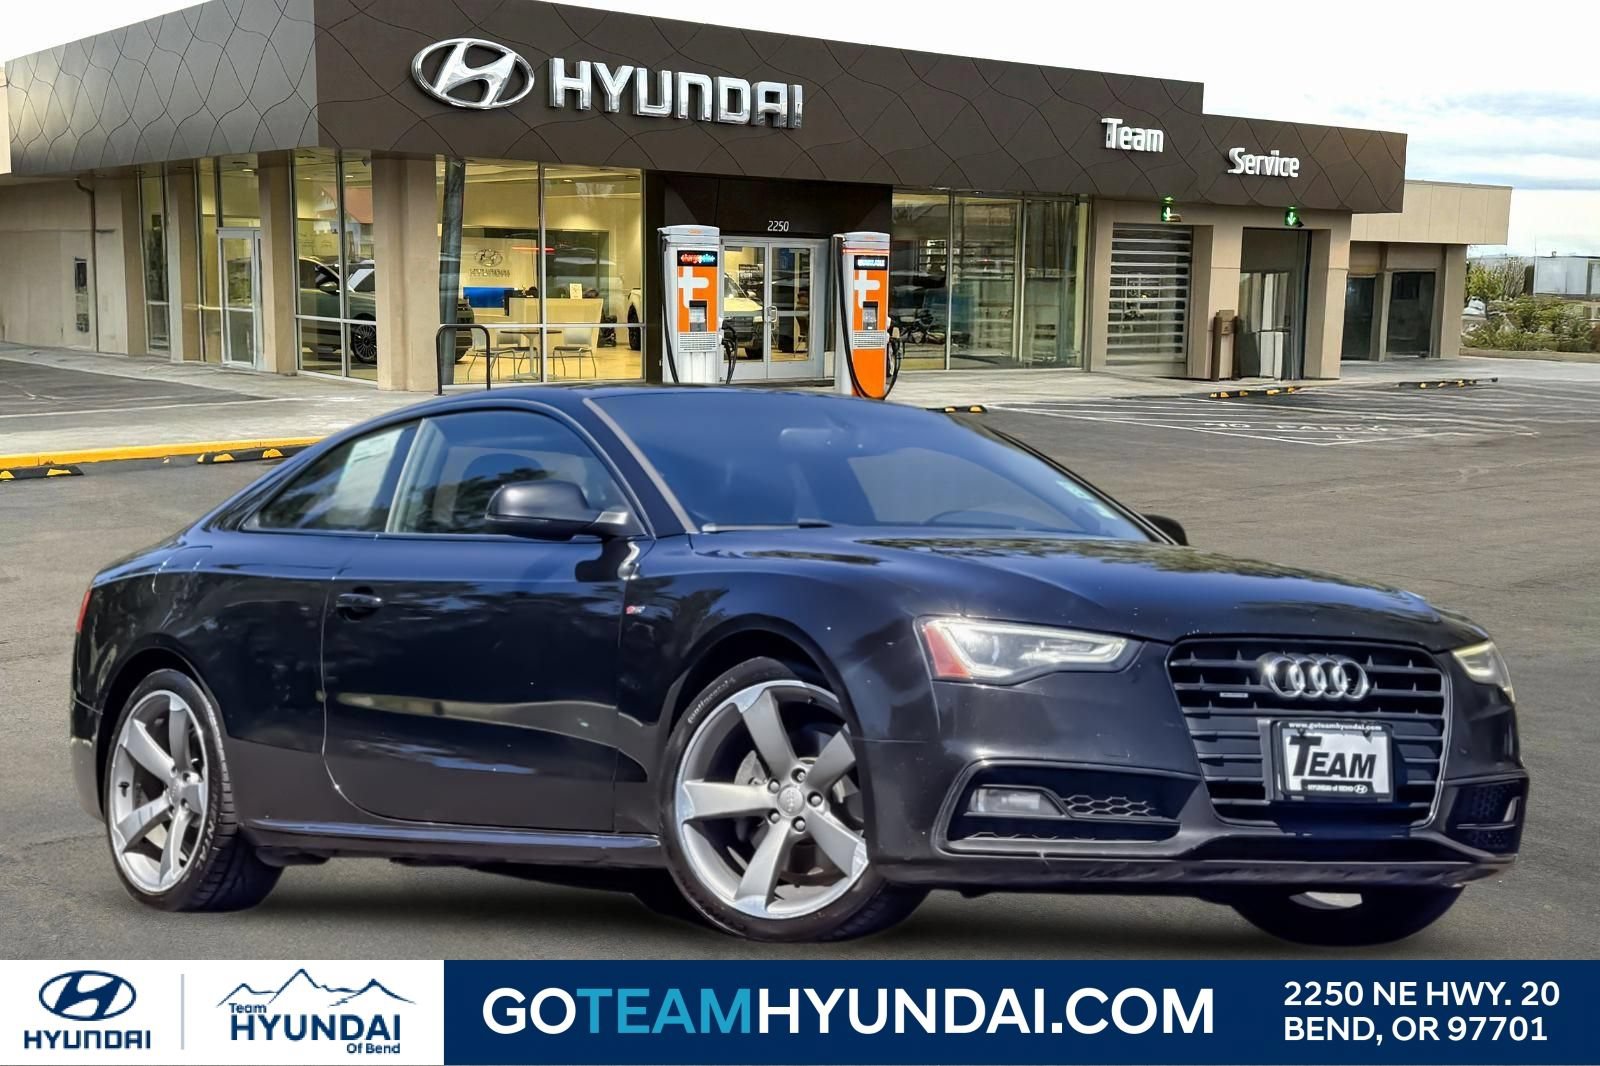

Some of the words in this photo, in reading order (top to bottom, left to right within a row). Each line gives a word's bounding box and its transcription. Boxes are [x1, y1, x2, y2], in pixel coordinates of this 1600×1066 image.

[548, 57, 803, 129] HYUNDAI
[1101, 117, 1164, 153] Team
[1227, 147, 1300, 178] Service
[767, 220, 790, 232] 2250
